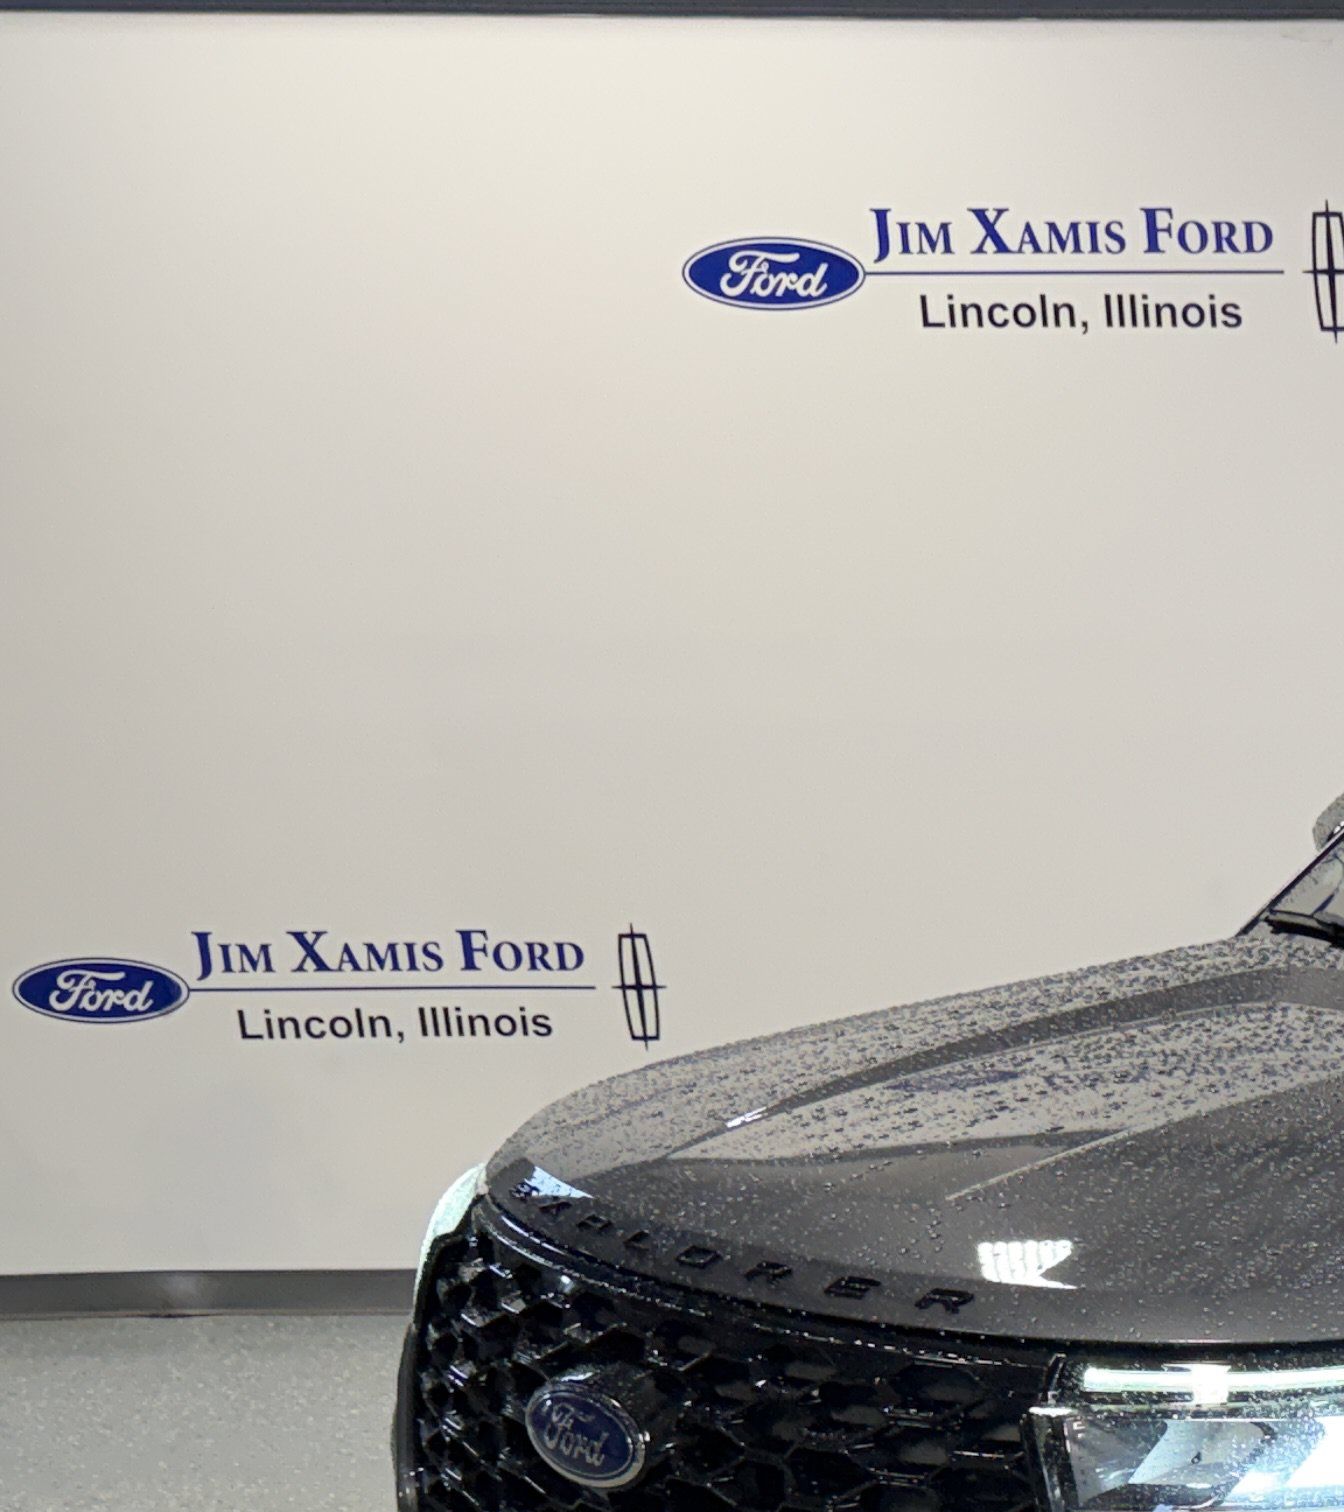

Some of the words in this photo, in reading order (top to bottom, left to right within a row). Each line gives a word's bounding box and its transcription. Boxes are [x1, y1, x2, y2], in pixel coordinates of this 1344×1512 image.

[869, 207, 955, 264] JIM
[966, 207, 1127, 256] XAMIS
[1139, 207, 1275, 255] FORD
[719, 249, 828, 299] Ford
[919, 293, 1090, 336] Lincoln,
[1103, 293, 1243, 330] Illinois
[190, 930, 276, 982] JIM
[285, 930, 445, 973] XAMIS
[455, 929, 586, 973] FORD
[48, 970, 153, 1014] Ford
[236, 1008, 406, 1044] Lincoln,
[417, 1006, 554, 1038] Illinois
[546, 1400, 609, 1468] Ford
